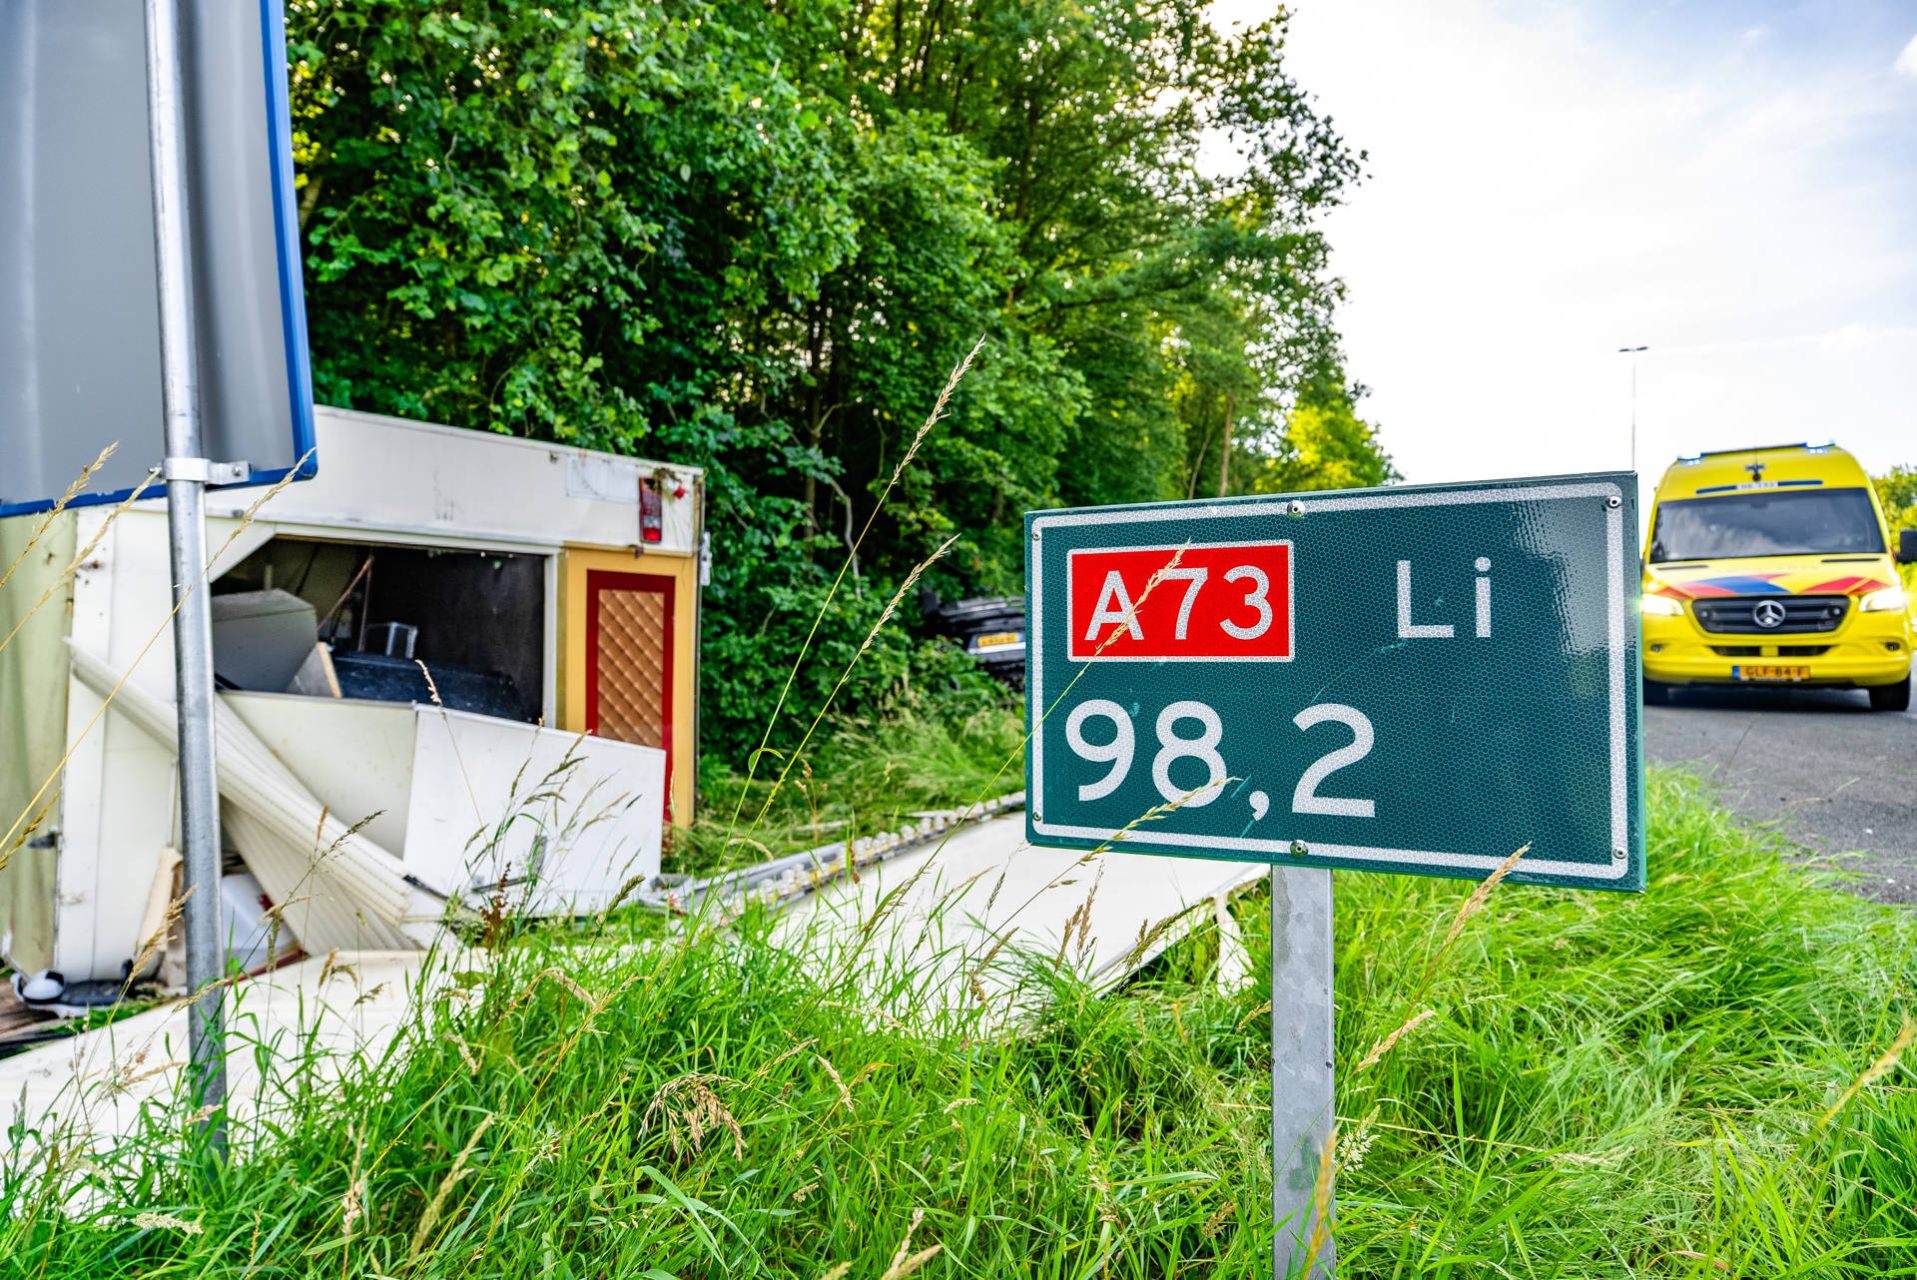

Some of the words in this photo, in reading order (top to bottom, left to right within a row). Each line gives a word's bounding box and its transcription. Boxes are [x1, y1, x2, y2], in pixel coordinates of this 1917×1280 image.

[1085, 565, 1273, 640] A73
[1397, 557, 1492, 638] Li
[1065, 699, 1375, 821] 98,2
